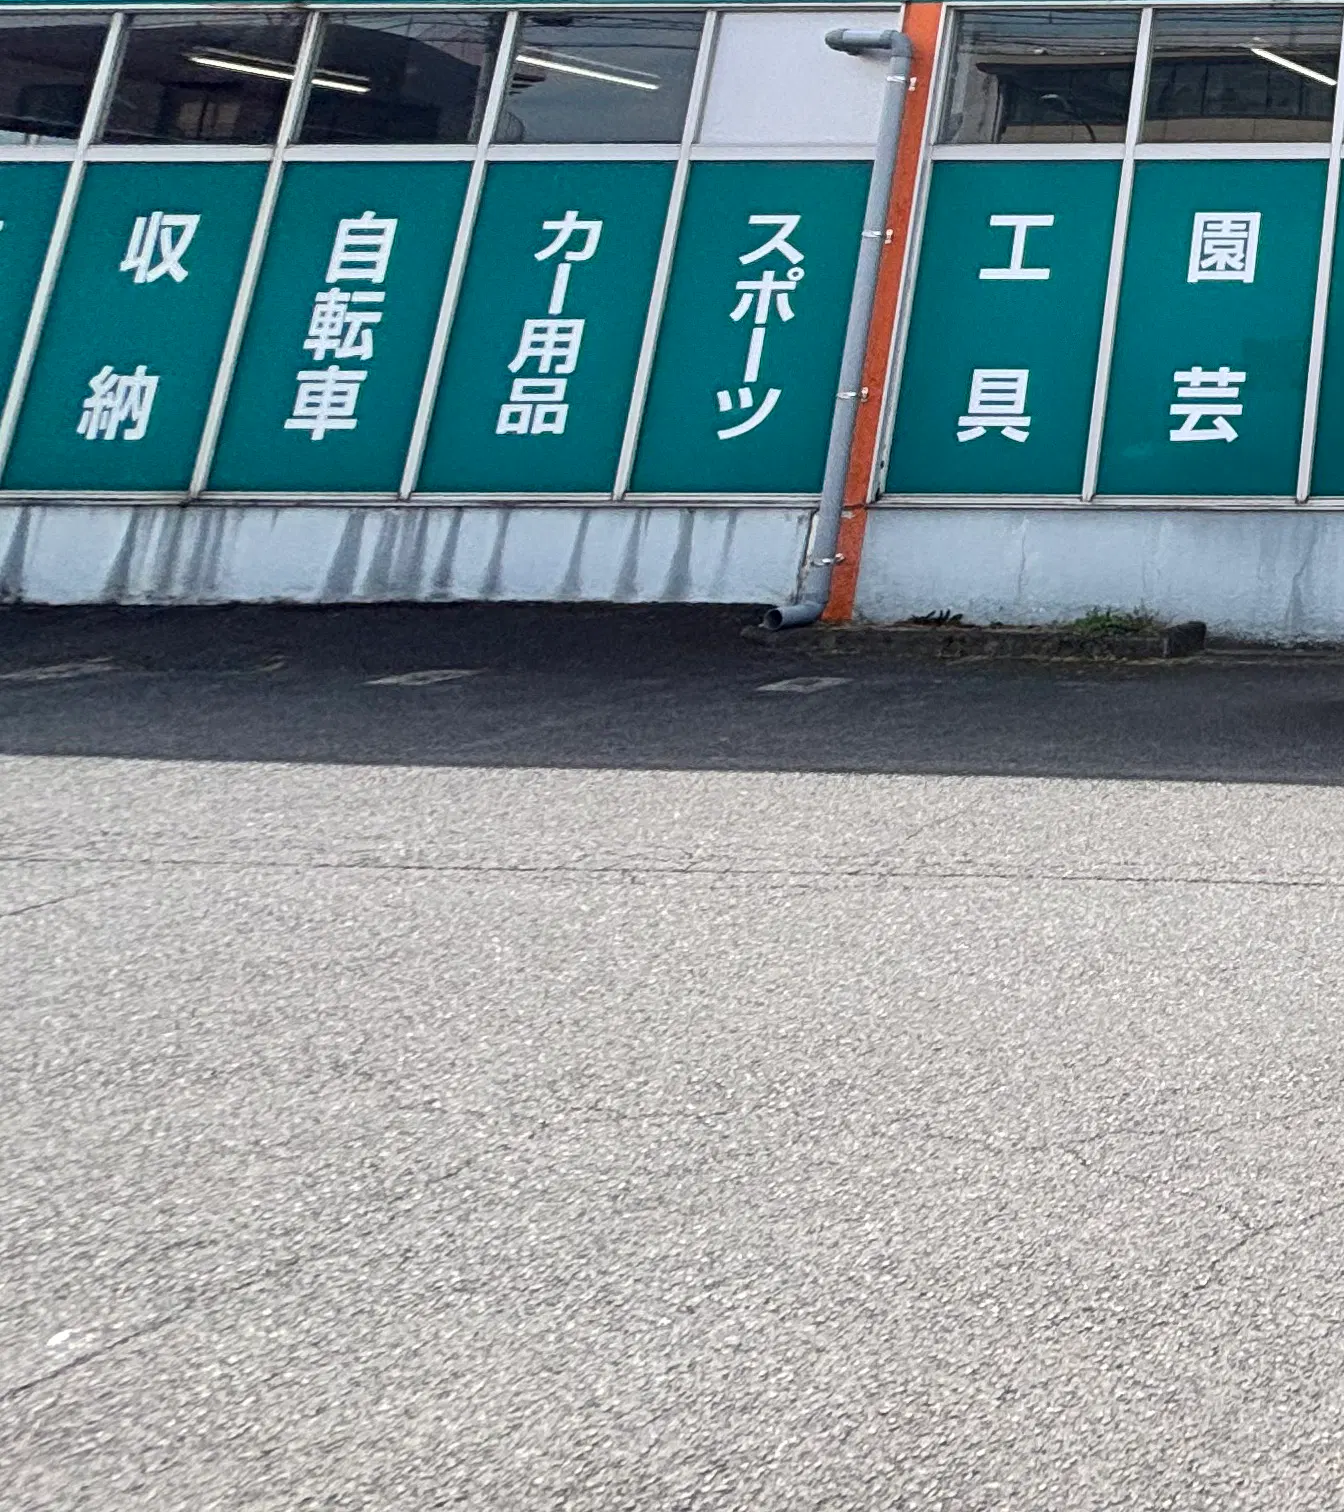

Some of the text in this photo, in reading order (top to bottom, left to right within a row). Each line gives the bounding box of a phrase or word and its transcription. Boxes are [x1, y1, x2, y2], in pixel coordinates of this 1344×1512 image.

[76, 212, 200, 441] 収納
[284, 211, 398, 441] 自転車
[496, 211, 603, 435] カー用品
[717, 214, 805, 440] スポーツ
[957, 214, 1055, 443] 工具
[1170, 211, 1262, 442] 園芸
